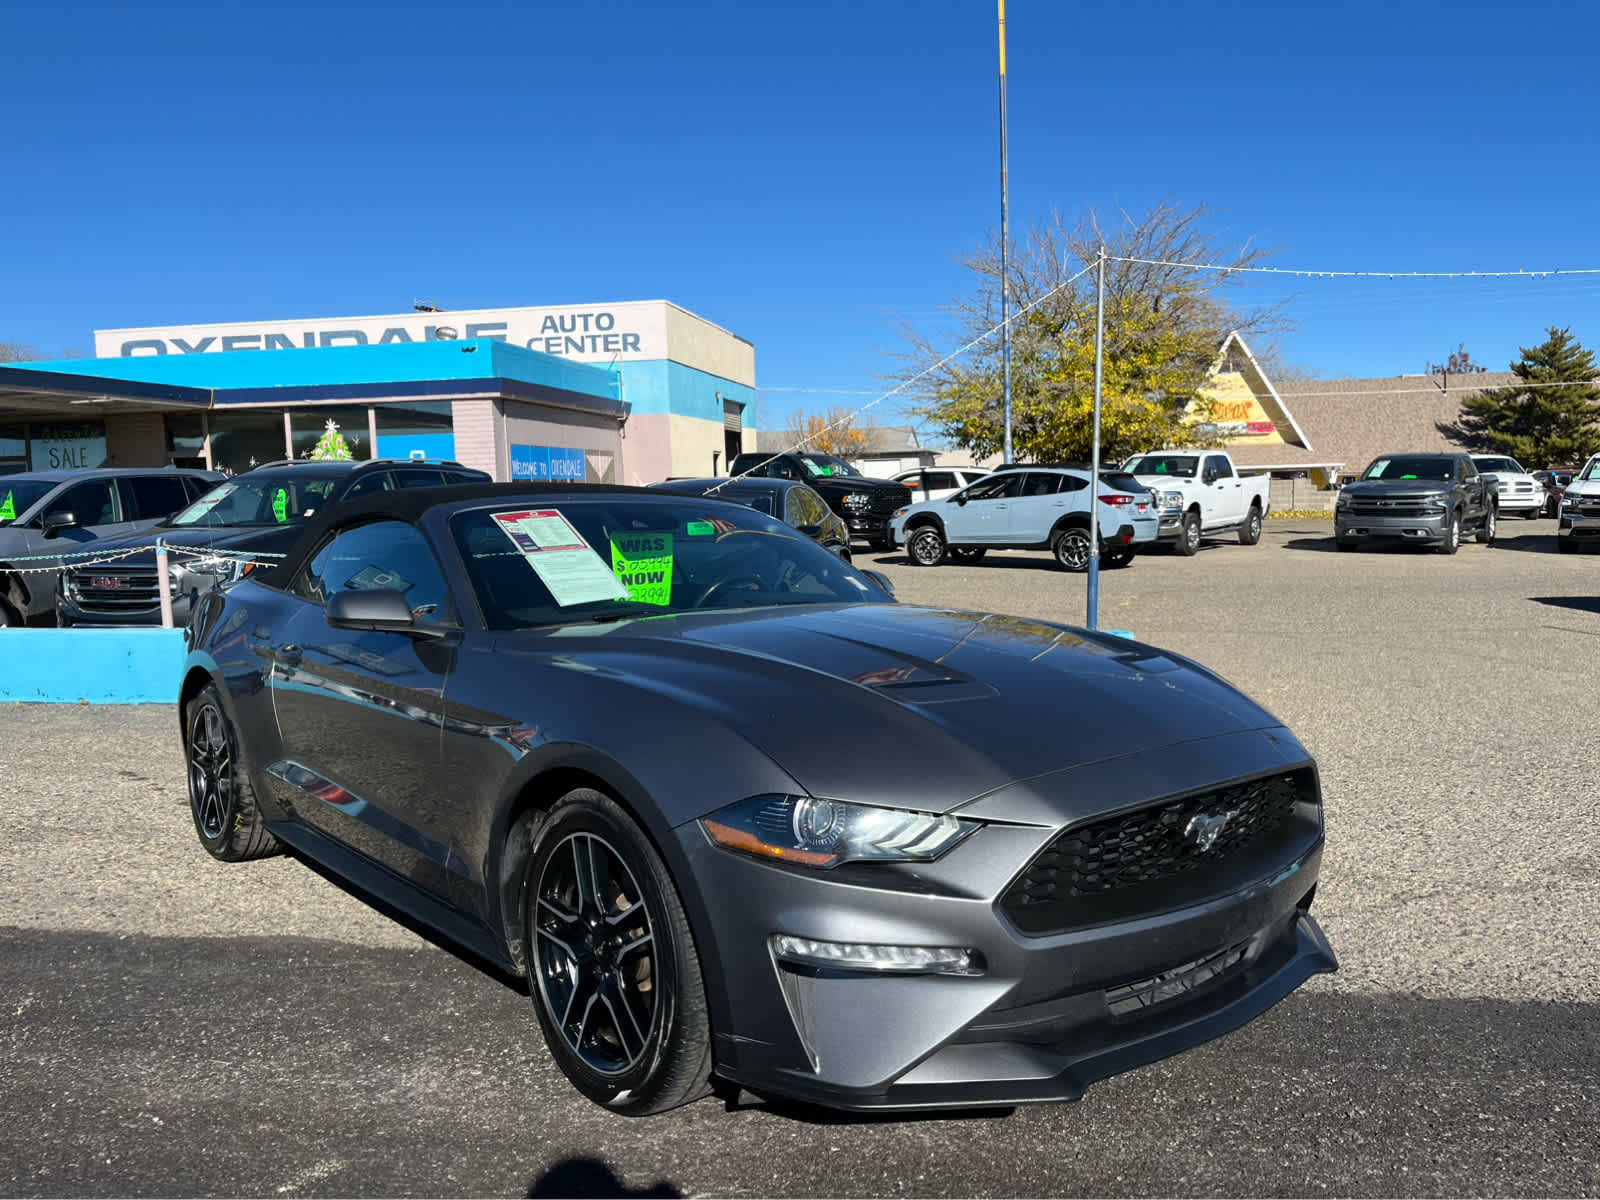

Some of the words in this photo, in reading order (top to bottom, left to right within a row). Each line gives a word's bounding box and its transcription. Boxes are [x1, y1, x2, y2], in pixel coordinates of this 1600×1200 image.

[540, 312, 615, 334] AUTO
[526, 333, 641, 355] CENTER
[48, 447, 88, 470] SALE
[619, 538, 665, 553] WAS
[90, 577, 130, 588] GMC
[621, 571, 665, 587] NOW
